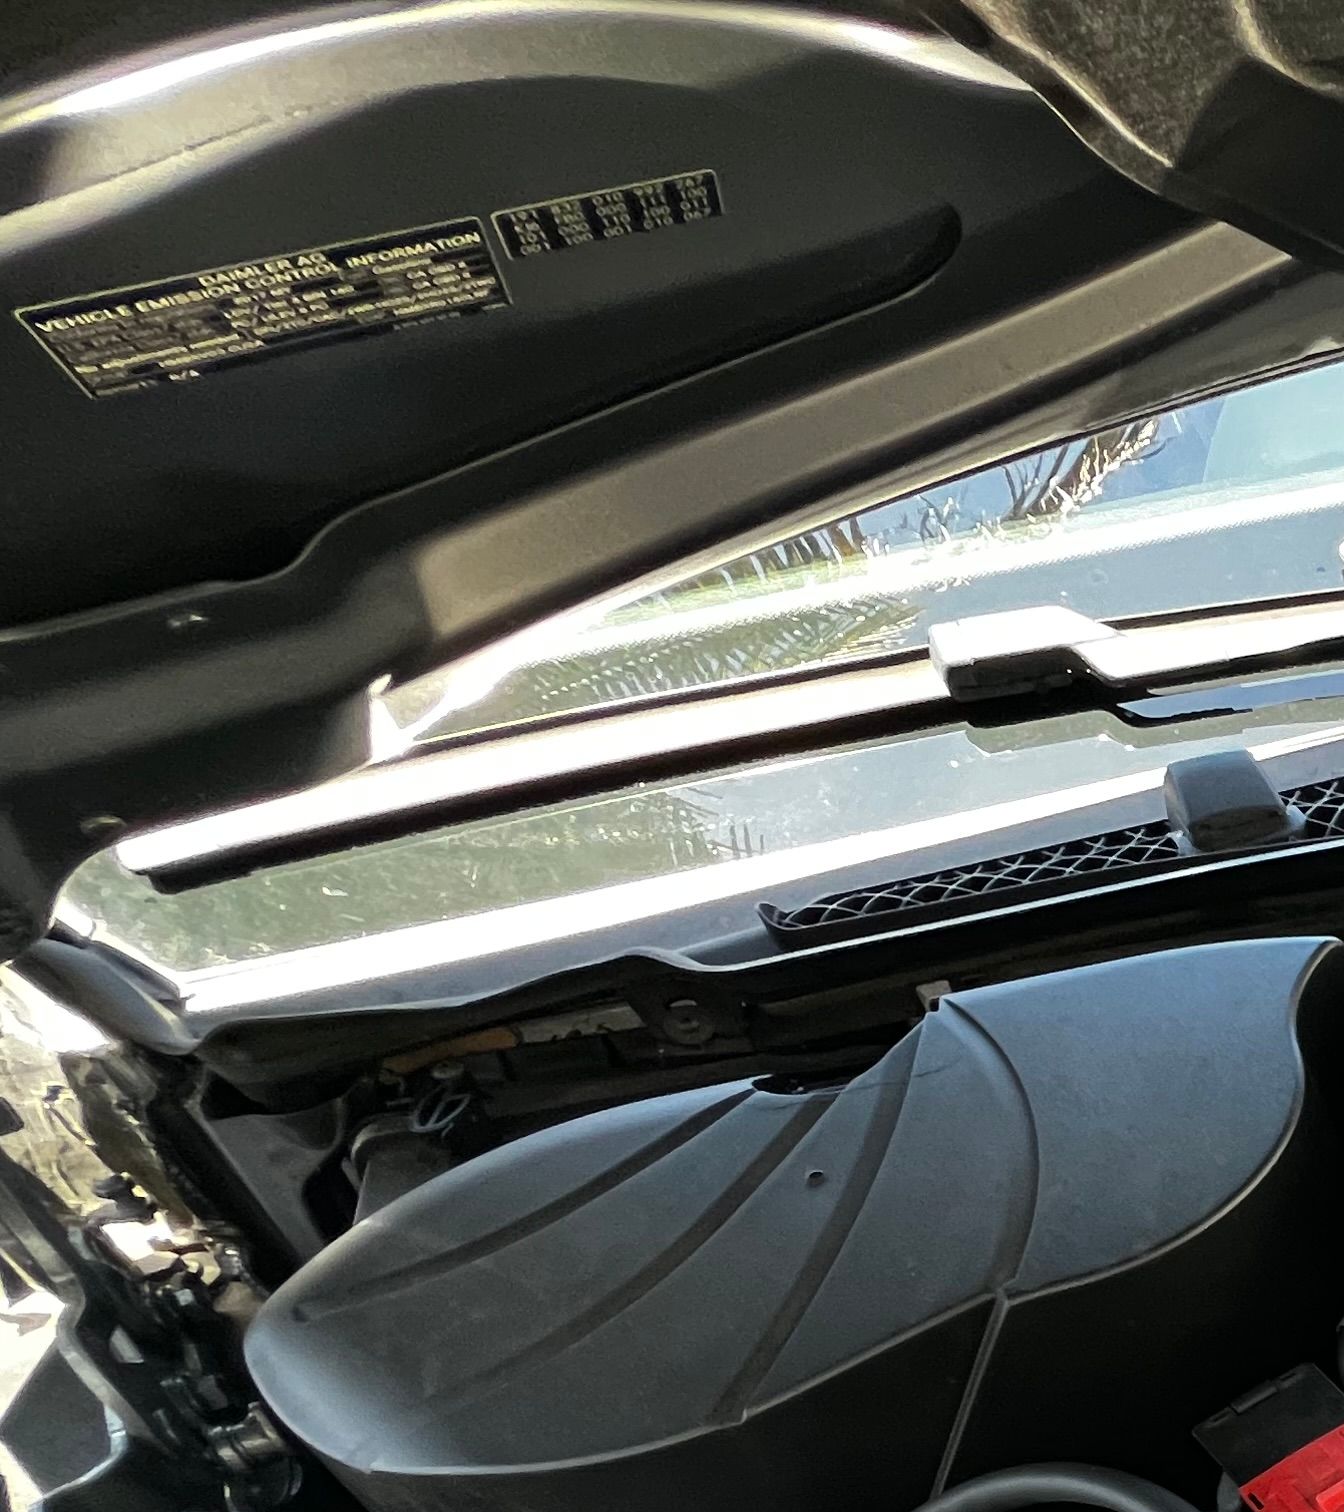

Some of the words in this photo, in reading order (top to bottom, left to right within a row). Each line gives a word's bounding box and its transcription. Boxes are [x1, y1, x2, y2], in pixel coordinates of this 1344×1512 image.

[34, 304, 133, 334] VEHICLE
[133, 281, 243, 313] EMISSION
[242, 260, 341, 290] CONTROL
[345, 230, 481, 269] INFORMATION
[197, 258, 294, 288] DAIMLER
[294, 251, 327, 267] AG
